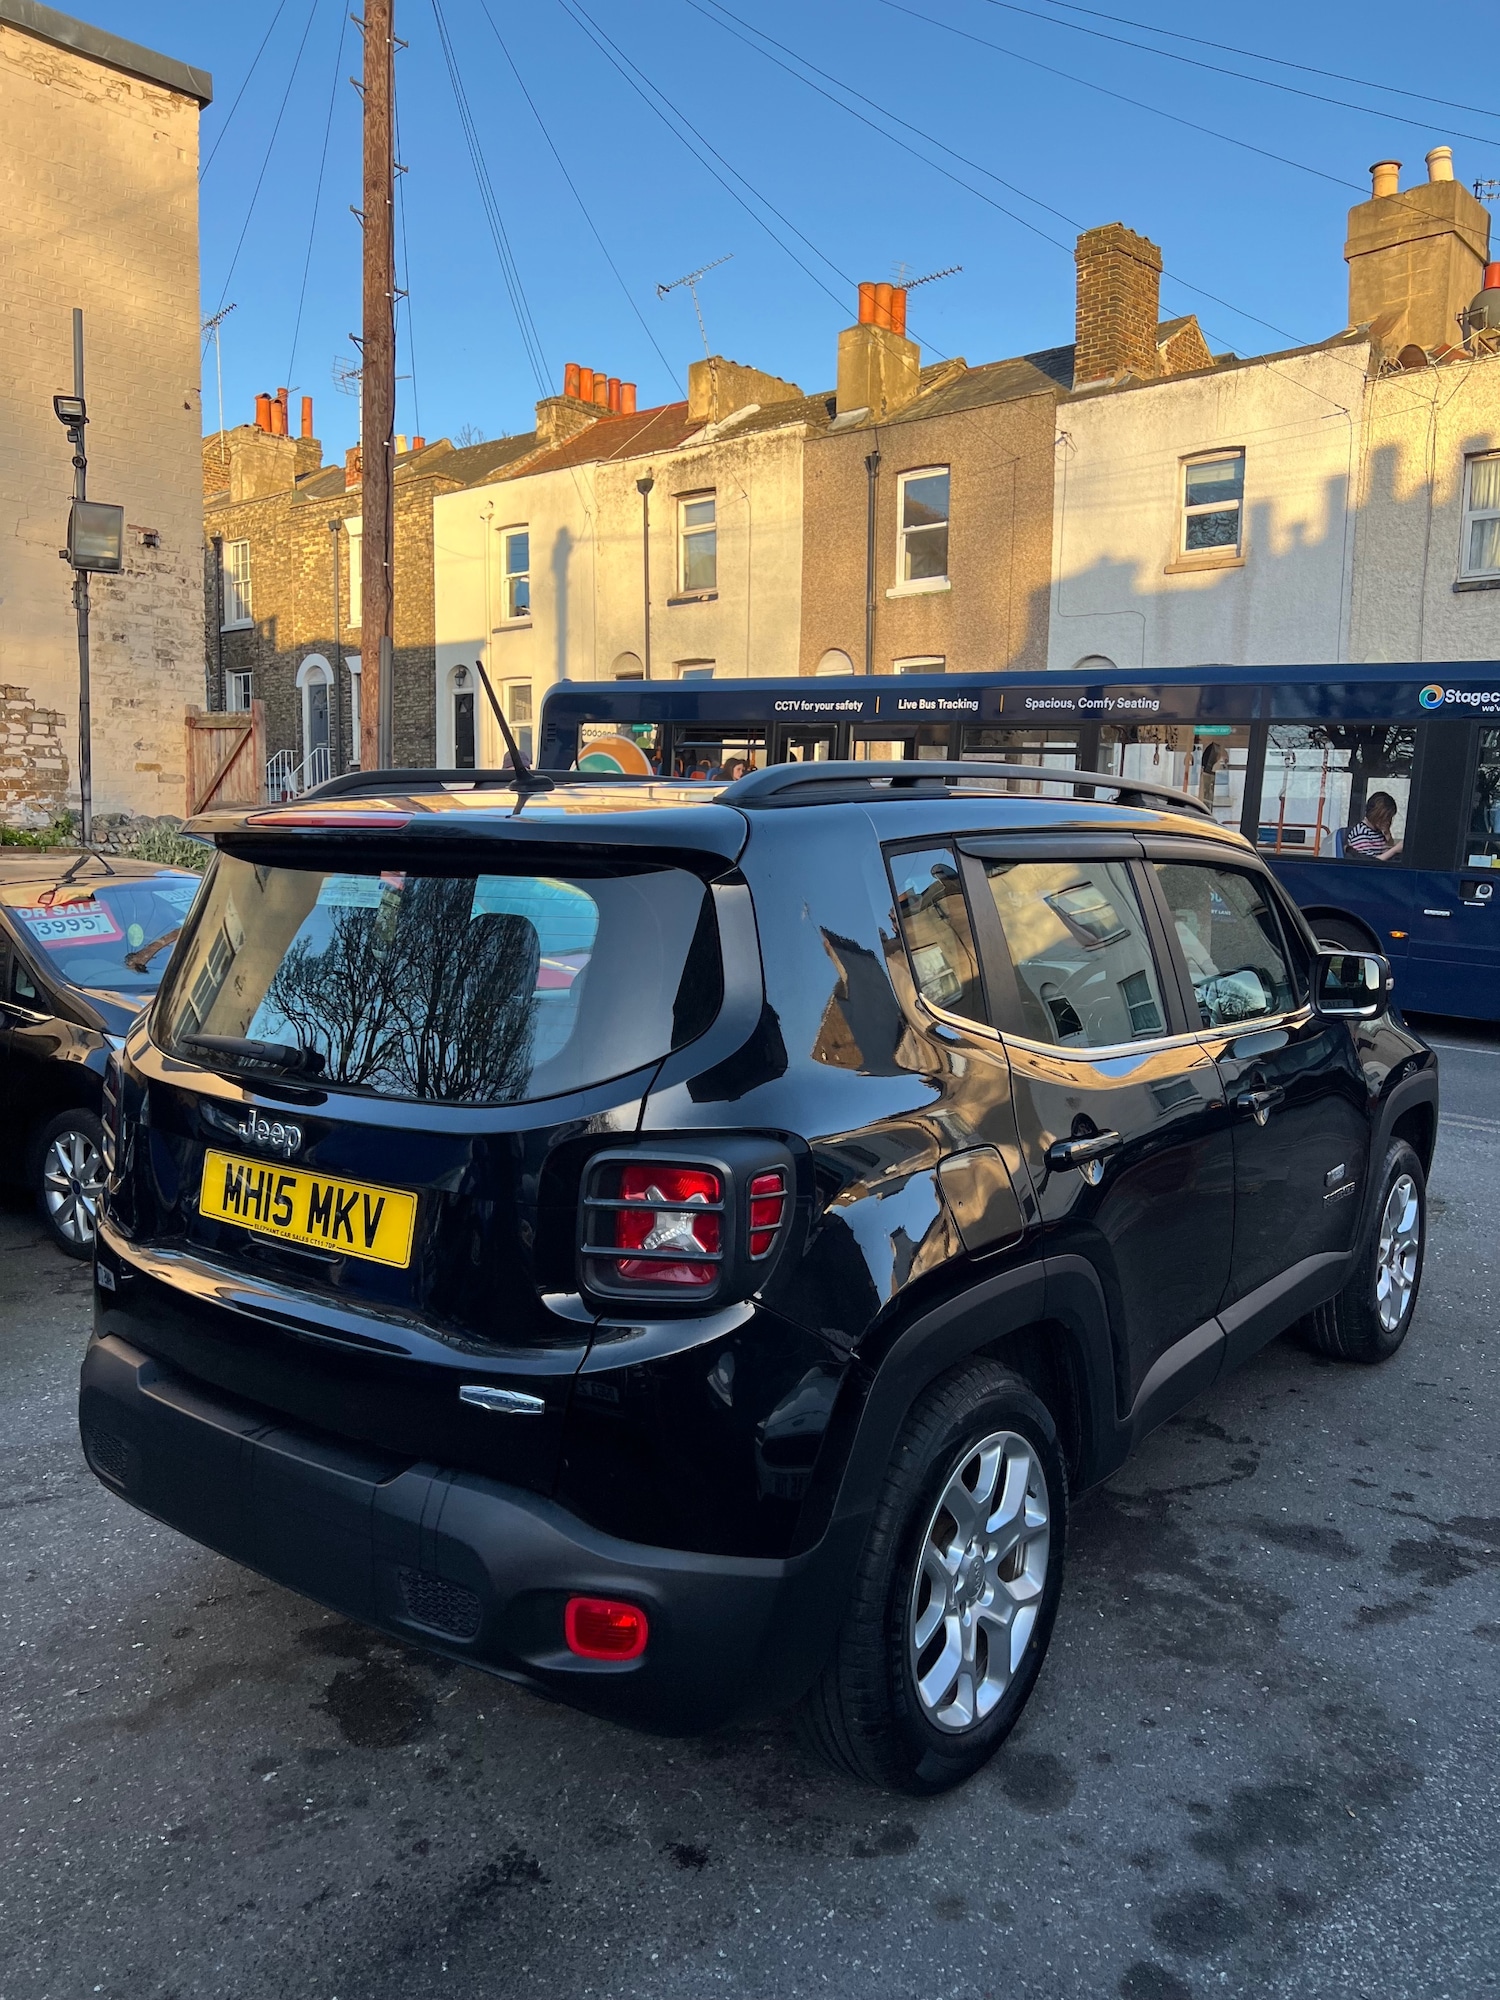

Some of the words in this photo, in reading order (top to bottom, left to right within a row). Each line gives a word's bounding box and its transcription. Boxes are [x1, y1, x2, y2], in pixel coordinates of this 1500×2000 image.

[774, 701, 800, 711] CCTV
[801, 700, 813, 711] for
[814, 702, 835, 713] your
[835, 700, 863, 712] safety
[898, 699, 917, 710] Live
[918, 699, 936, 710] Bus
[937, 698, 979, 711] Tracking
[1025, 697, 1076, 711] Spacious,
[1078, 697, 1115, 711] Comfy
[1117, 697, 1160, 711] Seating
[53, 901, 102, 916] SALE
[238, 1109, 302, 1158] Jeep
[222, 1163, 297, 1227] MH15
[306, 1182, 386, 1249] MKV
[254, 1223, 280, 1235] ELEPHANT
[281, 1230, 291, 1239] CAR
[292, 1233, 309, 1243] SALES
